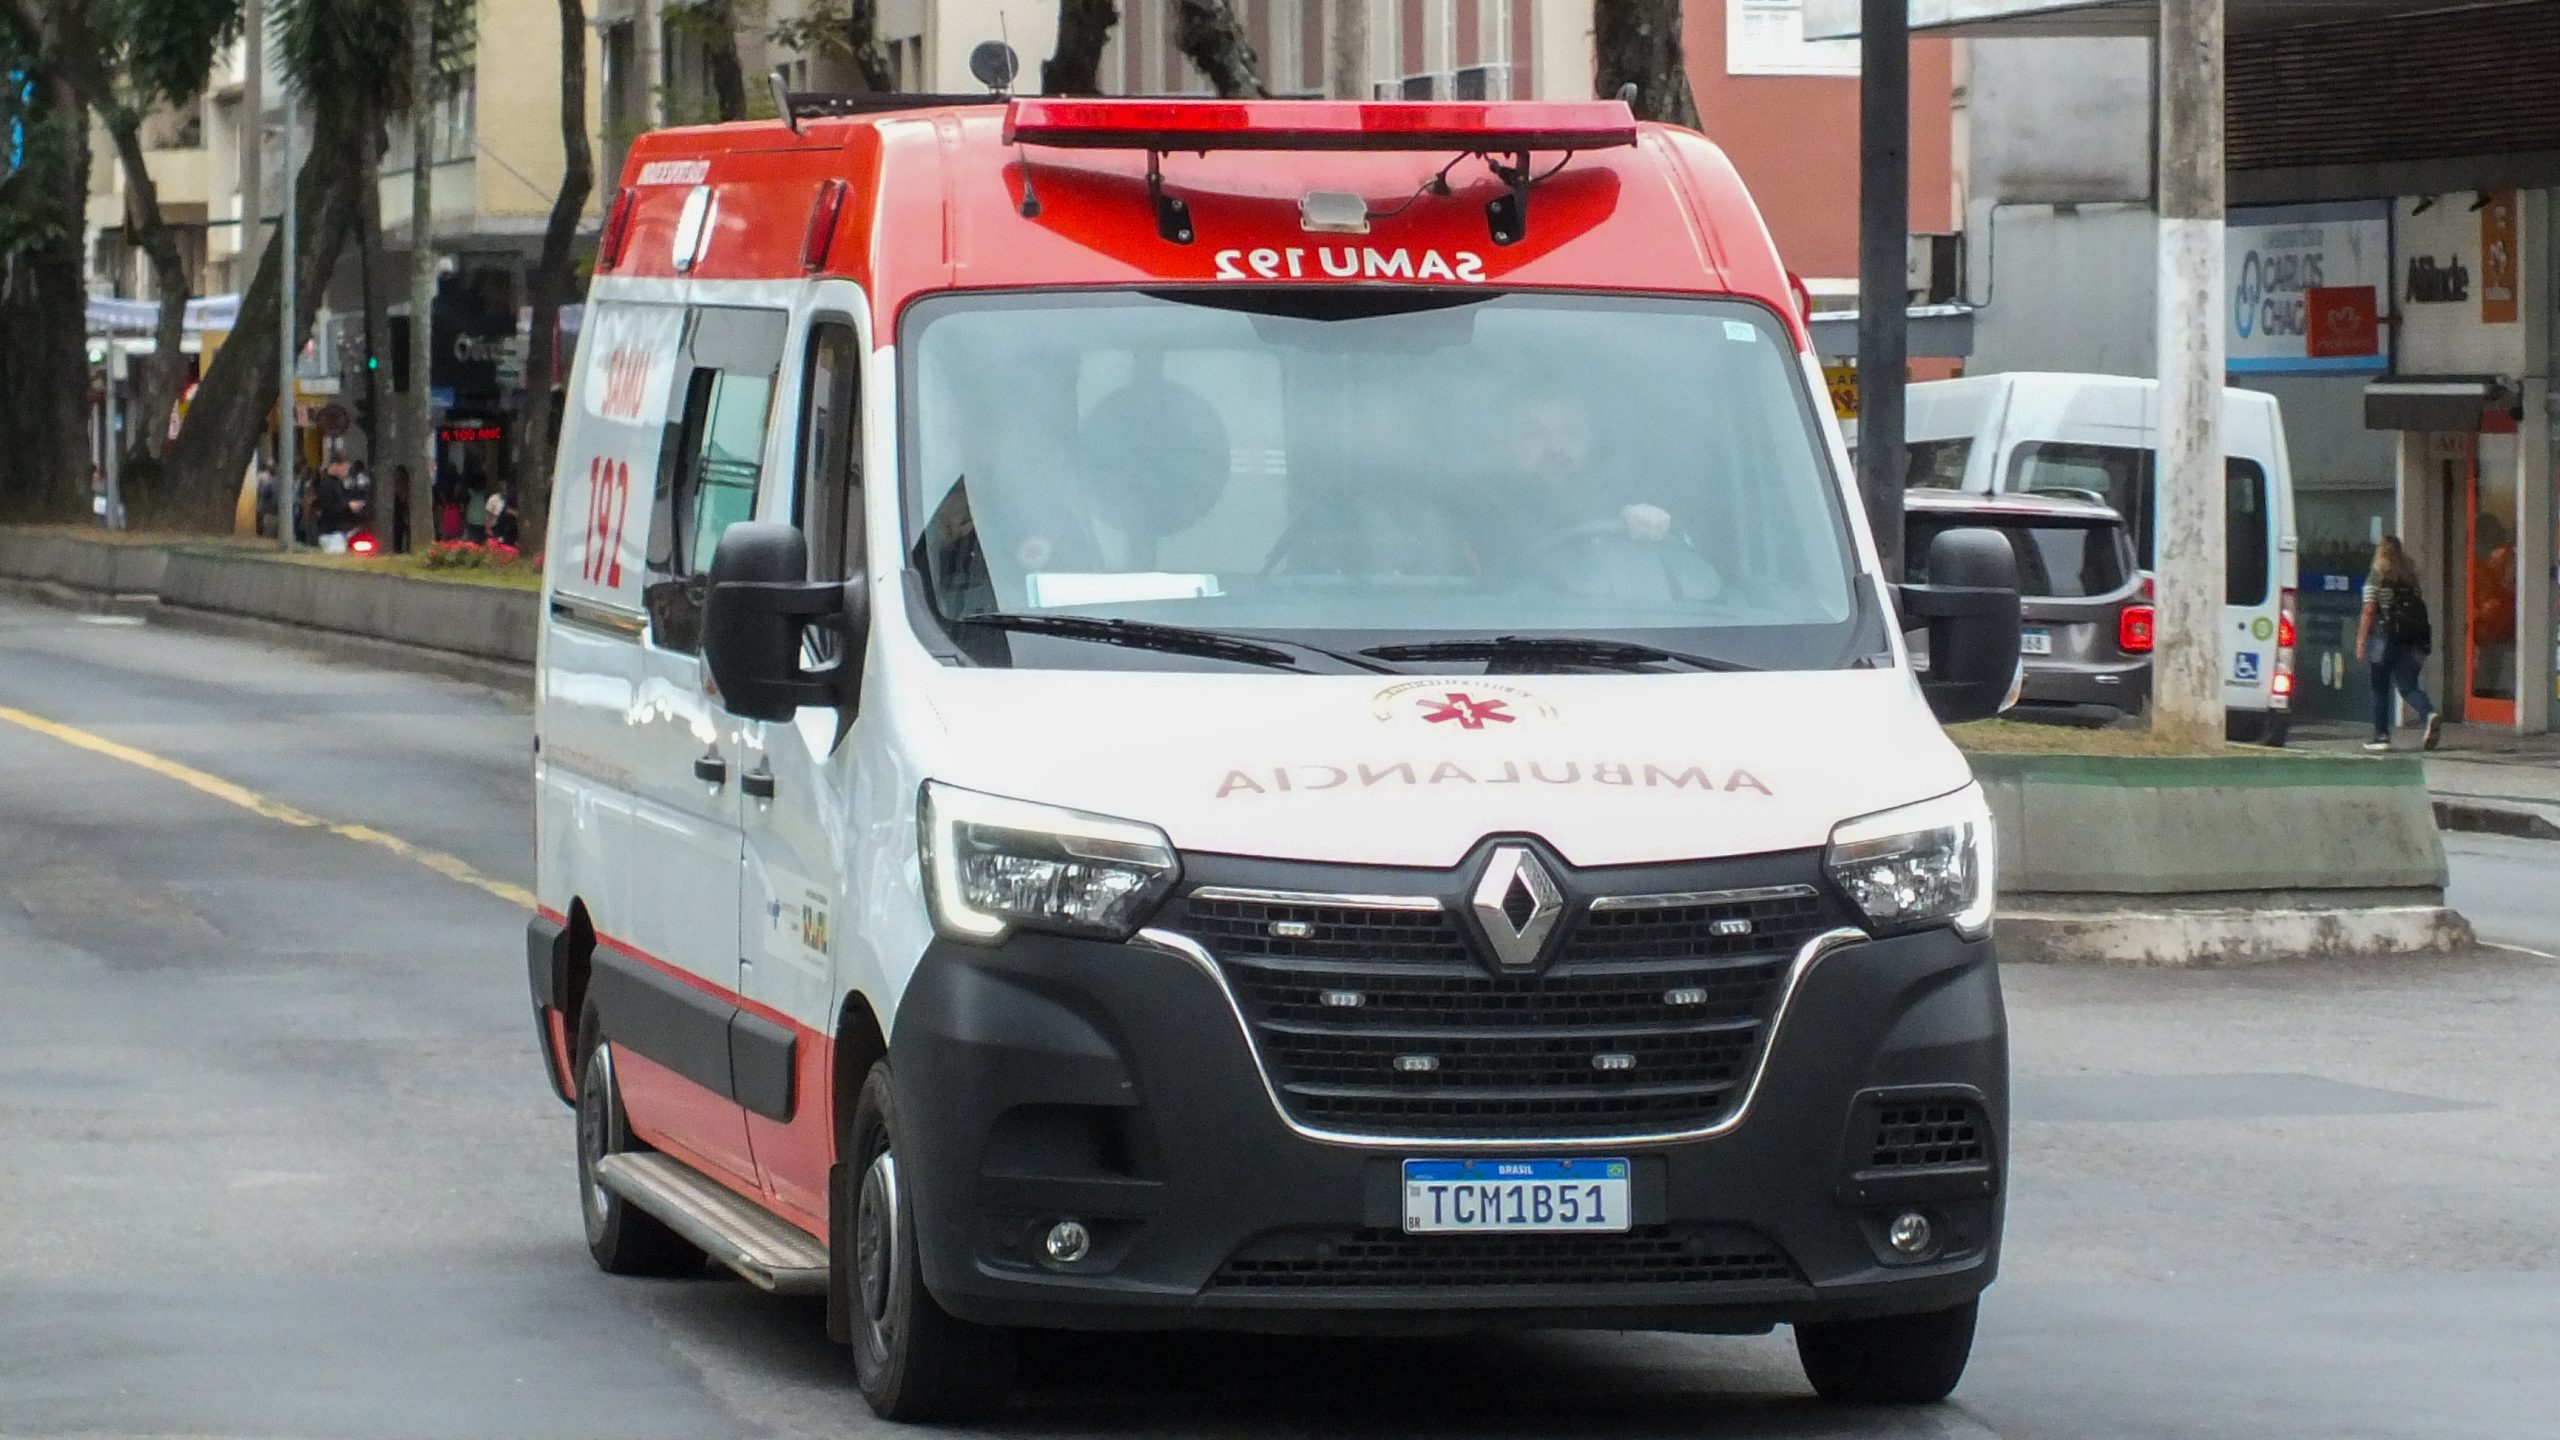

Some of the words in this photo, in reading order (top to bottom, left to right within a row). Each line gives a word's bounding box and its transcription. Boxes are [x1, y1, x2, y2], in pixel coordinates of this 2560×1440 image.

[2263, 253, 2324, 292] CARLOS
[584, 454, 629, 589] 192
[1498, 1165, 1534, 1176] BRASIL
[1408, 1216, 1422, 1230] BR
[1427, 1184, 1606, 1225] TCM1B51
